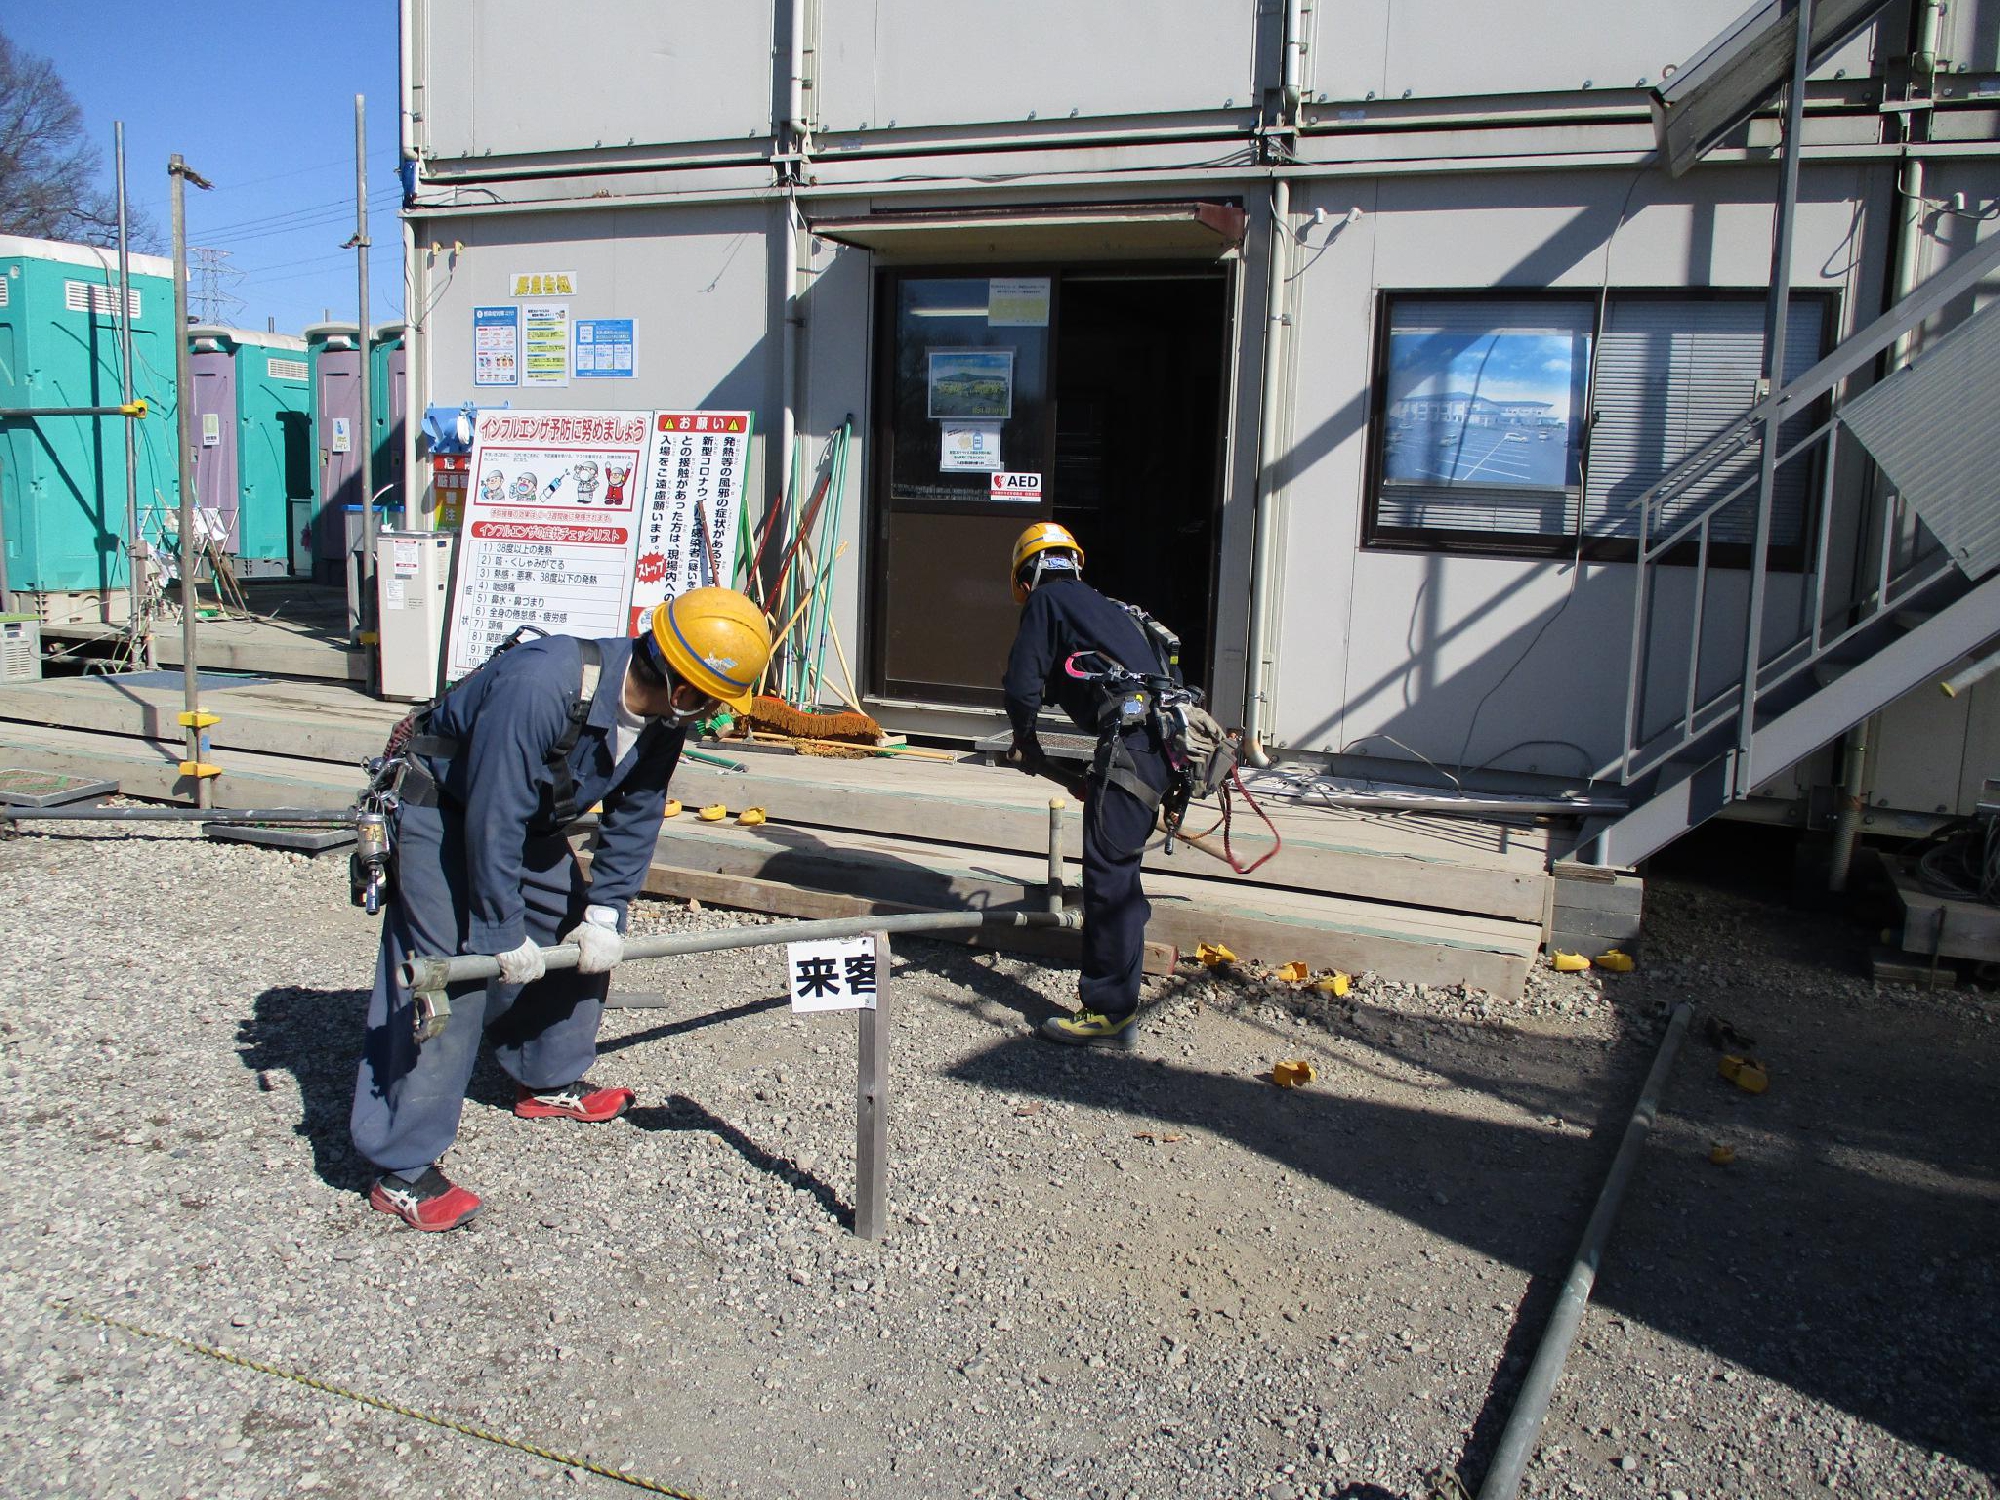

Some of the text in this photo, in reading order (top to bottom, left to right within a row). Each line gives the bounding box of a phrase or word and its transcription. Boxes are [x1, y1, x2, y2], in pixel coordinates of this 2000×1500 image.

[479, 415, 646, 443] インフルエンザ予防に努めましょう
[679, 416, 725, 431] お願い
[1007, 475, 1038, 487] AED
[480, 522, 620, 542] インフルエンザの症状チェックリスト
[796, 953, 876, 997] 来客
